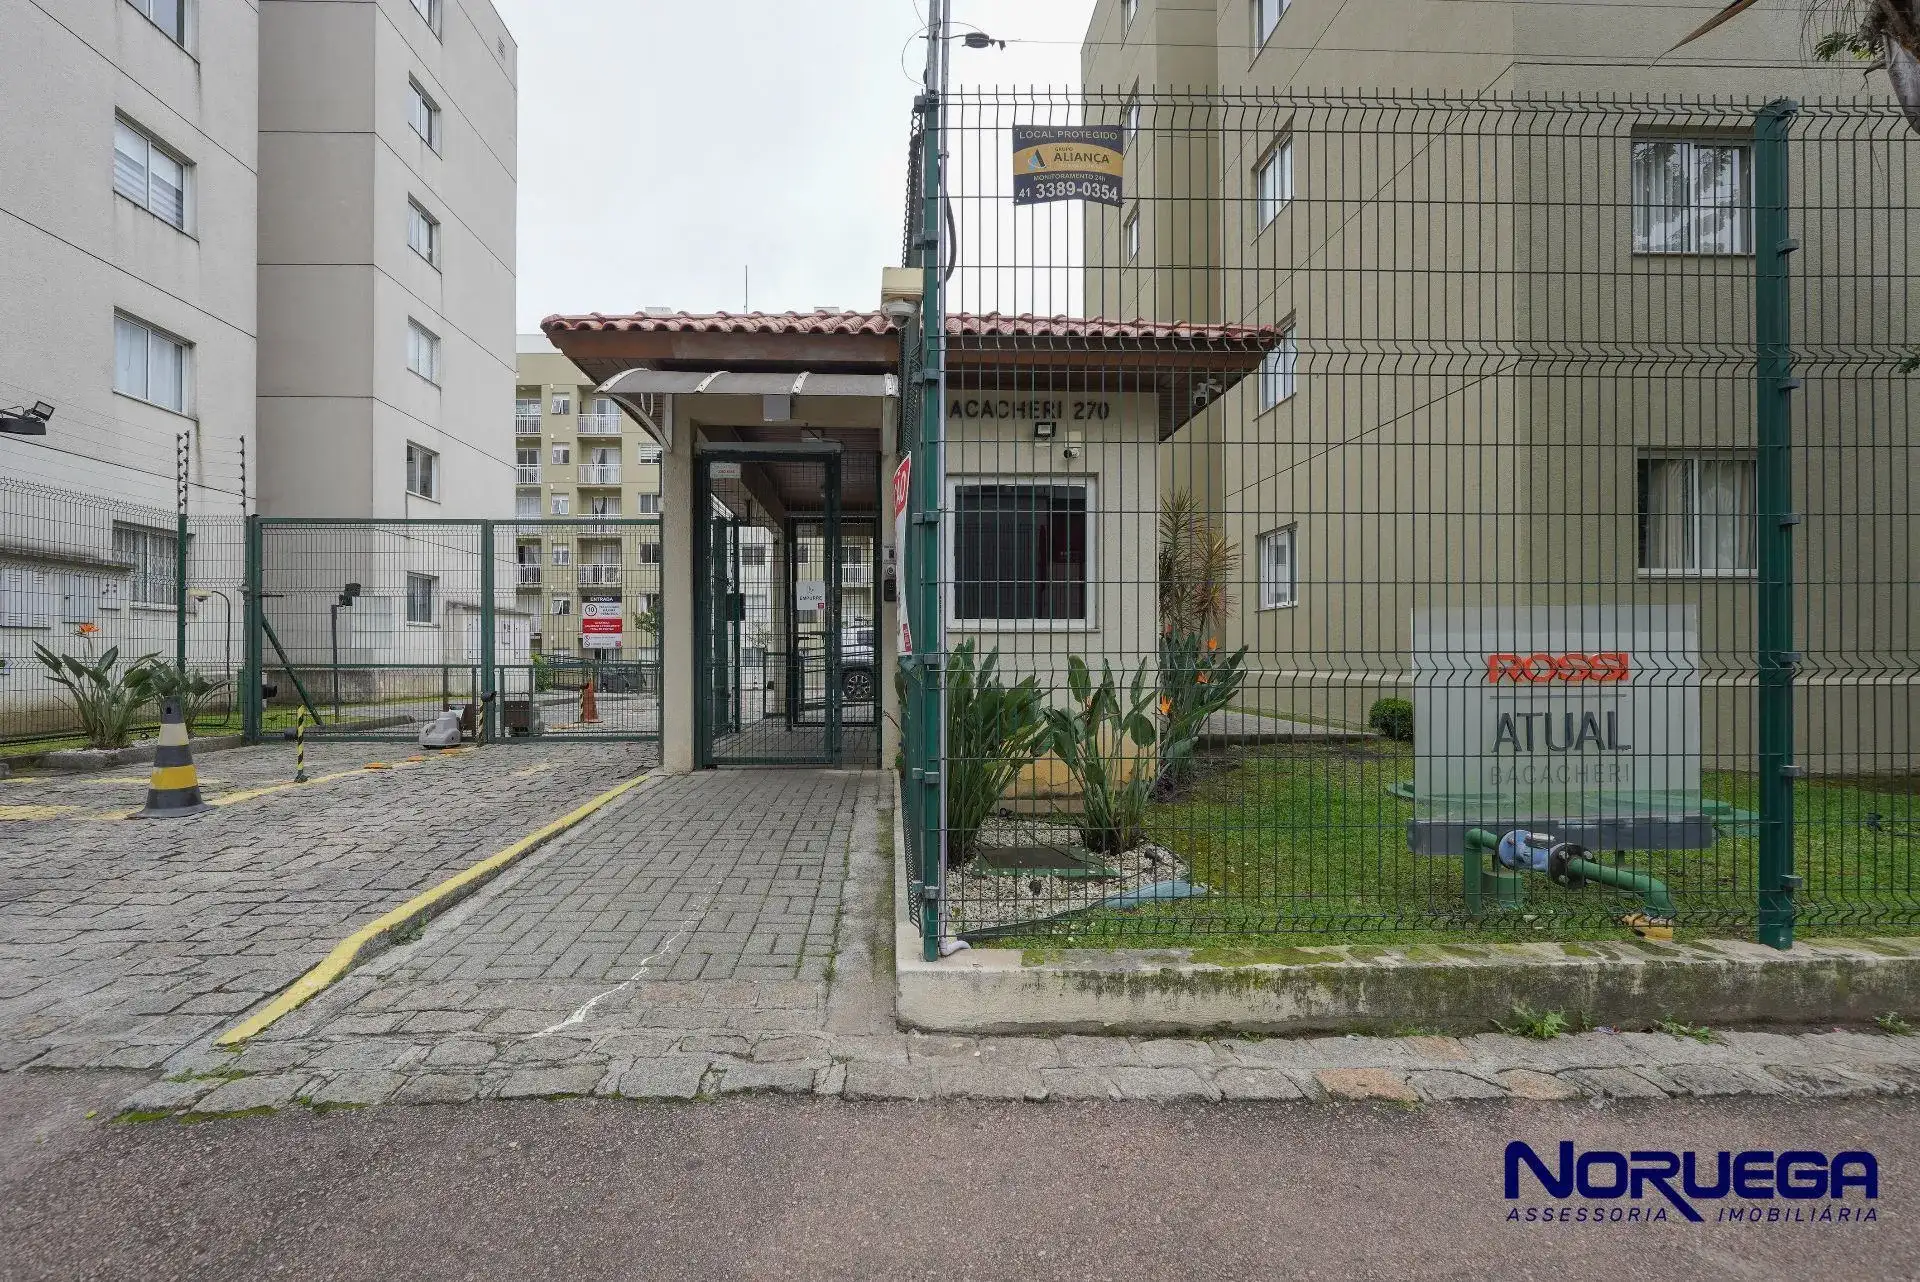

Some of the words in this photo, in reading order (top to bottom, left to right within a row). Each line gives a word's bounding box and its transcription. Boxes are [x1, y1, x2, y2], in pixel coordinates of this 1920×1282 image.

[1020, 130, 1055, 140] LOCAL
[1057, 130, 1118, 141] PROTEGIDO
[1053, 152, 1110, 165] ALIANÇA
[1033, 173, 1094, 182] MONITORAMENTO
[1019, 188, 1030, 198] 41
[1036, 181, 1119, 202] 3389-0354
[949, 400, 1062, 419] ACACHERI
[1074, 401, 1110, 420] 270
[1488, 652, 1629, 683] ROSSI
[1491, 711, 1632, 752] ATUAL
[1491, 764, 1629, 786] BACACHERI
